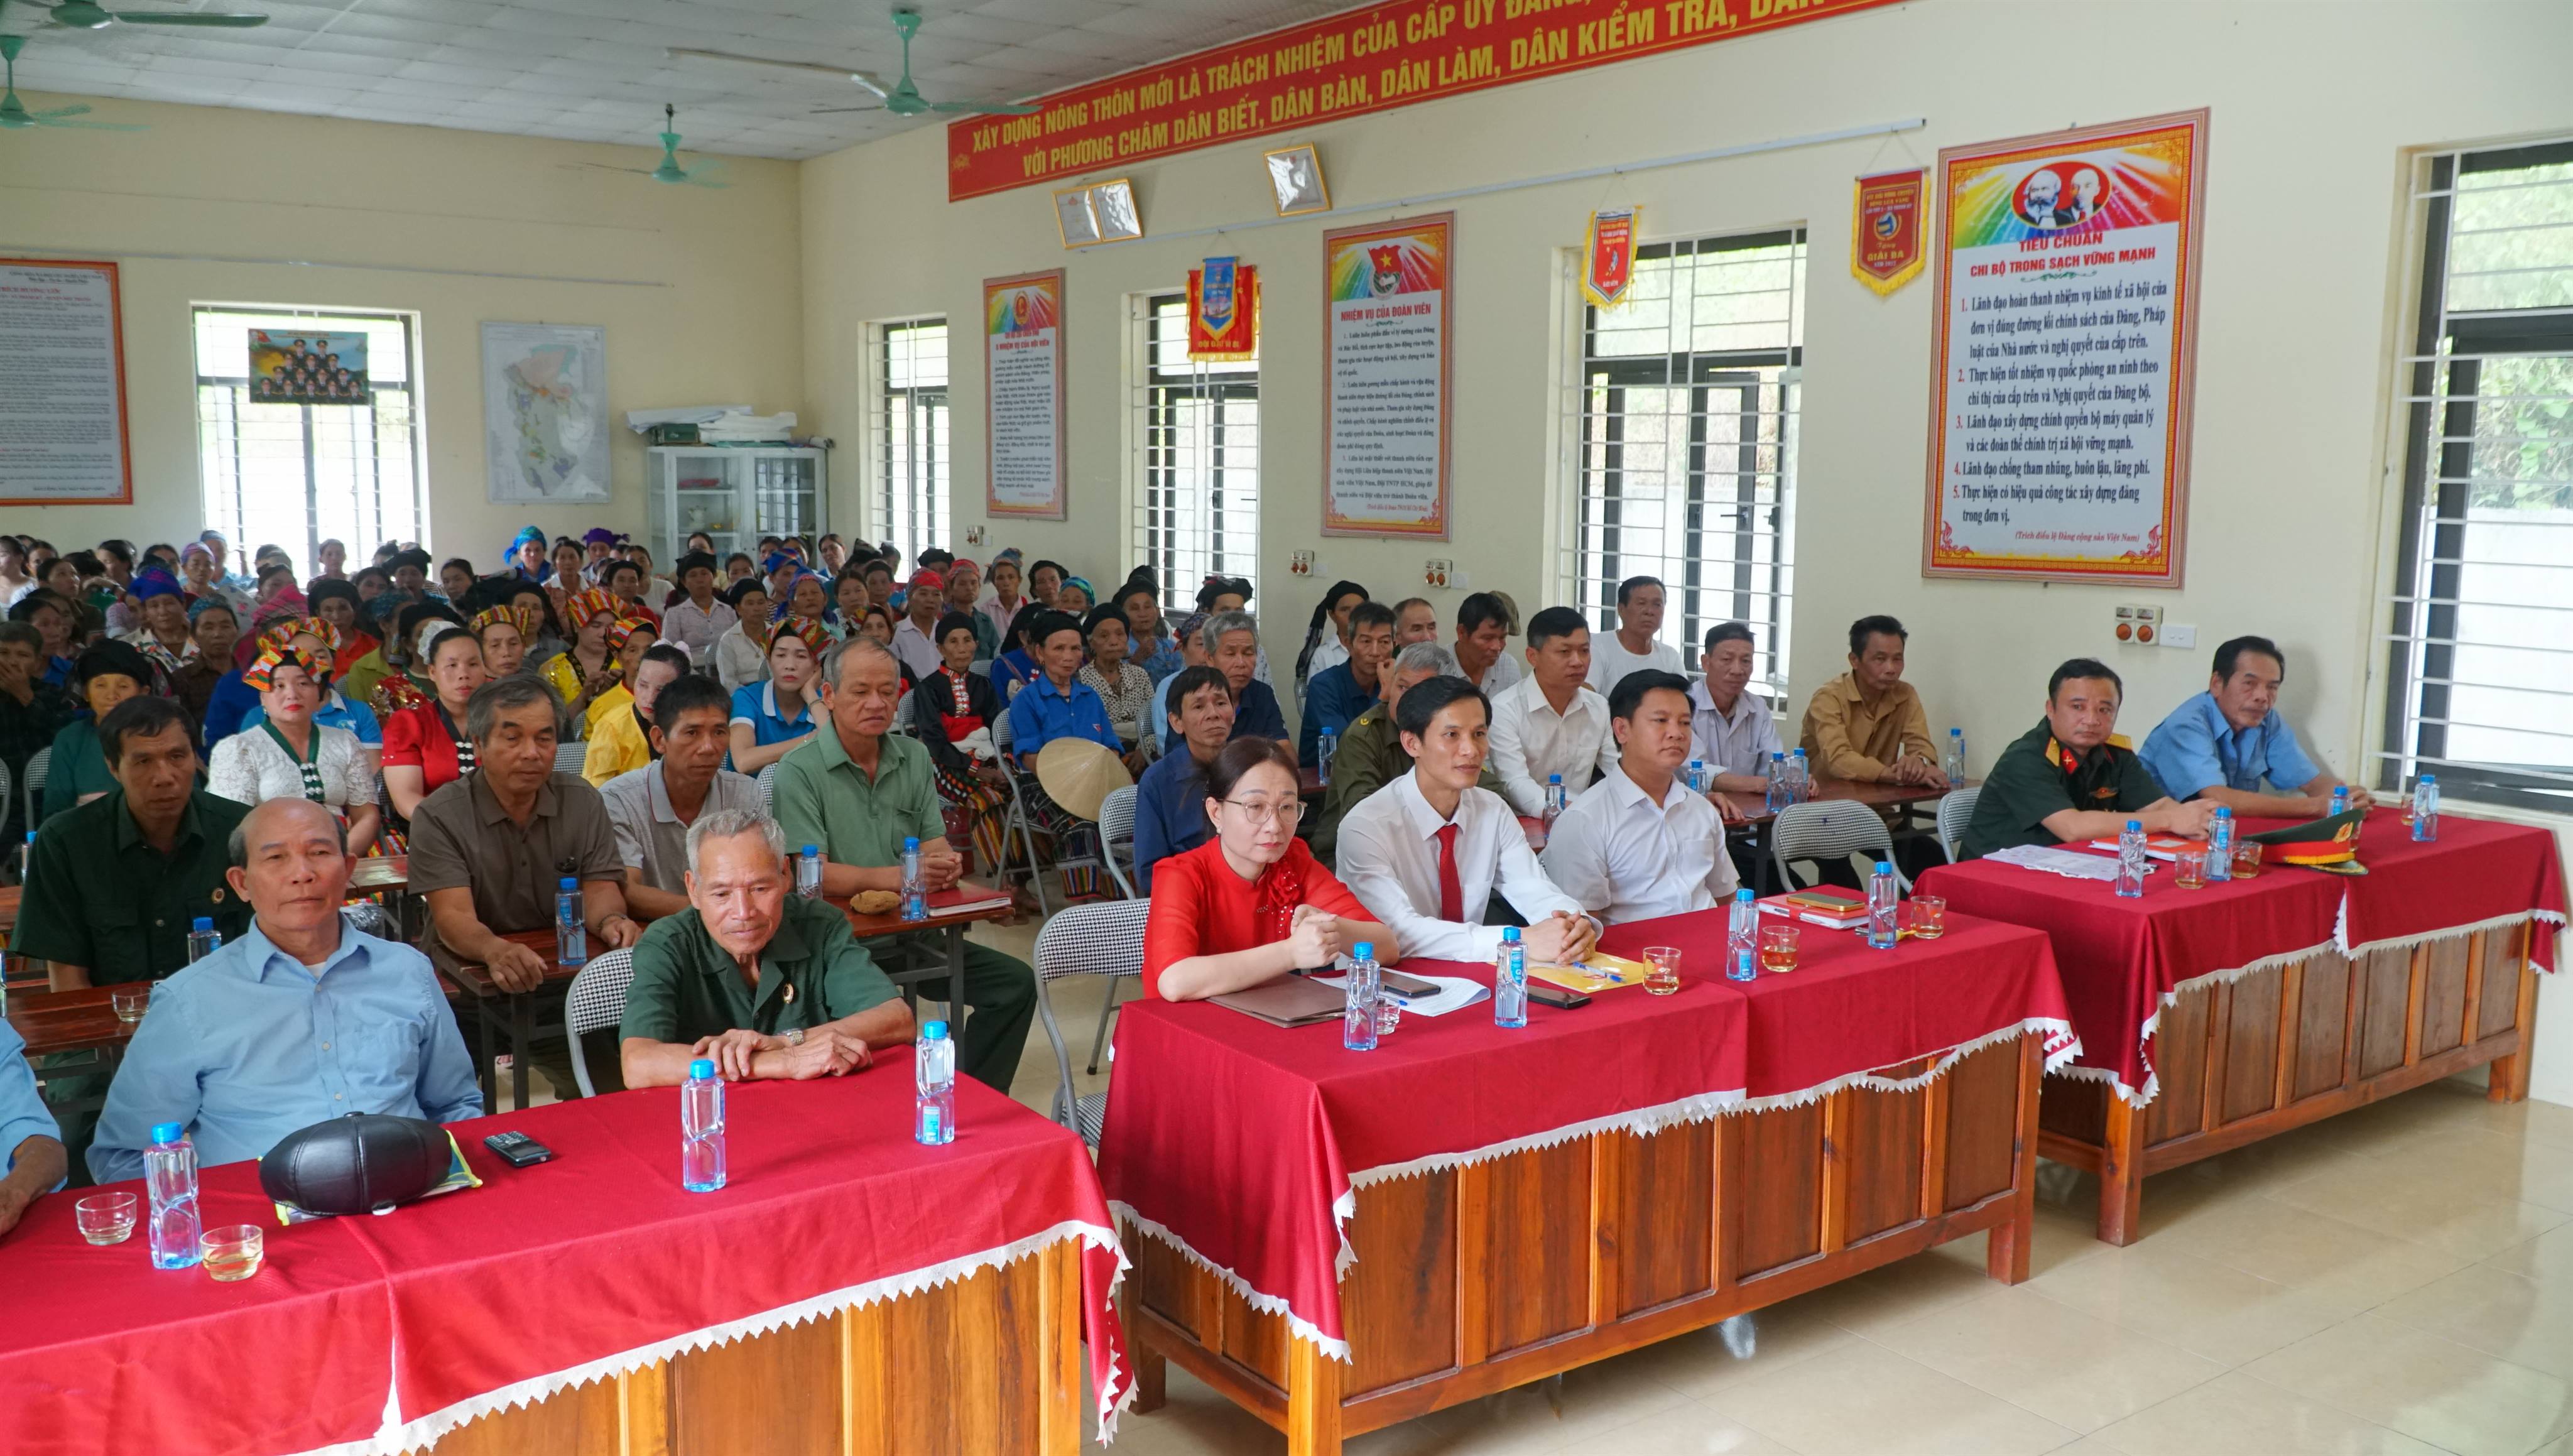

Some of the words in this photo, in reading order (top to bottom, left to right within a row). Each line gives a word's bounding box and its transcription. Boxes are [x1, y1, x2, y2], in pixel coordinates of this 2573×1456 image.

[973, 124, 999, 153] XÂY
[1003, 117, 1042, 149] DỰNG
[1045, 102, 1087, 134] NÔNG
[1092, 88, 1134, 122] THÔN
[1140, 73, 1173, 111] MỚI
[1179, 67, 1201, 102] LÀ
[1207, 53, 1268, 94] TRÁCH
[1275, 33, 1345, 77] NHIỆM
[1352, 12, 1398, 57] CỦA
[1023, 144, 1046, 177] VỚI
[1050, 138, 1113, 171] PHƯƠNG
[1118, 117, 1168, 156] CHÂM
[1173, 112, 1212, 144] DÂN
[1217, 93, 1265, 136] BIẾT,
[1271, 86, 1314, 123] DÂN
[1321, 73, 1374, 112] BÀN,
[1381, 59, 1431, 99] DÂN
[1438, 45, 1501, 86] LÀM,
[1510, 27, 1569, 70] DÂN
[1578, 1, 1655, 57] KIỂM
[1665, 0, 1738, 37] TRA,
[1971, 265, 1988, 276] CHI
[1991, 261, 2005, 276] BỘ
[2010, 258, 2045, 273] TRONG
[2049, 255, 2079, 271] SẠCH
[2084, 251, 2114, 265] VỮNG
[2119, 247, 2156, 265] MẠNH
[1961, 298, 1967, 312] 1.
[1972, 296, 1991, 311] Lãnh
[1993, 295, 2007, 313] đạo
[2010, 293, 2028, 308] hoàn
[2055, 288, 2079, 307] nhiệm
[2082, 291, 2091, 306] vụ
[2094, 286, 2111, 301] kinh
[2115, 280, 2122, 299] tế
[2125, 283, 2133, 298] xã
[2137, 282, 2150, 301] hội
[2152, 281, 2167, 296] của
[1341, 308, 1363, 323] NHIỆM
[1366, 309, 1374, 322] VỤ
[1376, 305, 1390, 318] CỦA
[1393, 304, 1412, 317] ĐOÀN
[1414, 302, 1431, 315] VIÊN
[1971, 321, 1984, 335] đơn
[1988, 320, 1994, 337] vị
[1996, 319, 2015, 336] đúng
[2017, 317, 2042, 334] đường
[2044, 311, 2053, 329] lối
[2055, 312, 2077, 329] chính
[2080, 312, 2097, 327] sách
[2100, 310, 2114, 325] của
[2117, 309, 2140, 327] Đảng,
[2144, 306, 2165, 325] Pháp
[1970, 344, 1983, 361] luật
[1986, 344, 1999, 357] của
[2001, 342, 2016, 357] Nhà
[2019, 341, 2038, 356] nước
[2040, 340, 2049, 354] và
[2052, 339, 2069, 357] nghị
[2071, 332, 2093, 356] quyết
[2095, 336, 2109, 350] của
[2112, 330, 2126, 353] cấp
[2129, 333, 2148, 349] trên.
[1958, 368, 1964, 382] 2.
[1969, 368, 1988, 385] Thực
[1990, 366, 2006, 384] hiện
[2008, 362, 2018, 379] tốt
[2021, 364, 2044, 383] nhiệm
[2047, 367, 2055, 381] vụ
[2059, 359, 2077, 381] quốc
[2079, 362, 2104, 380] phòng
[2107, 364, 2116, 374] an
[2119, 359, 2138, 374] ninh
[2140, 359, 2158, 373] theo
[1981, 391, 1991, 408] thị
[1993, 390, 2005, 404] của
[2008, 385, 2021, 408] cấp
[2023, 388, 2038, 403] trên
[2042, 388, 2050, 401] và
[2053, 388, 2071, 406] Nghị
[2073, 382, 2095, 405] quyết
[2098, 385, 2111, 400] của
[2114, 385, 2136, 403] Đảng
[2139, 383, 2151, 403] bộ.
[1956, 415, 1962, 428] 3.
[1967, 415, 1986, 428] Lãnh
[1989, 413, 2002, 431] đạo
[2004, 413, 2017, 431] xây
[2020, 413, 2038, 431] dựng
[2041, 412, 2062, 427] chính
[2065, 408, 2087, 430] quyền
[2091, 410, 2100, 429] bộ
[2103, 410, 2120, 428] máy
[2123, 410, 2143, 428] quản
[2146, 408, 2154, 427] lý
[1967, 438, 1974, 452] và
[1977, 438, 1988, 452] các
[1991, 438, 2008, 452] đoàn
[2011, 433, 2022, 451] thể
[2025, 437, 2045, 451] chính
[2048, 437, 2057, 454] trị
[2060, 436, 2069, 450] xã
[2071, 436, 2083, 454] hội
[2086, 436, 2106, 454] vững
[2108, 435, 2133, 454] mạnh.
[1954, 462, 1961, 475] 4.
[1963, 462, 1981, 475] Lãnh
[1984, 462, 1997, 479] đạo
[1999, 457, 2021, 479] chống
[2024, 461, 2043, 475] tham
[2045, 460, 2072, 479] nhũng,
[2074, 460, 2094, 474] buôn
[2097, 459, 2111, 479] lậu,
[2114, 460, 2131, 478] lãng
[2134, 459, 2150, 479] phí.
[1954, 486, 1959, 498] 5.
[1962, 485, 1980, 502] Thực
[1983, 485, 1998, 503] hiện
[2000, 485, 2008, 499] có
[2011, 484, 2026, 503] hiệu
[2029, 485, 2043, 503] quả
[2045, 484, 2064, 503] công
[2066, 485, 2077, 499] tác
[2079, 484, 2094, 503] xây
[2096, 486, 2116, 503] dựng
[2119, 485, 2139, 503] đảng
[1963, 509, 1983, 525] trong
[1984, 509, 1998, 522] đơn
[2001, 508, 2010, 525] vị.
